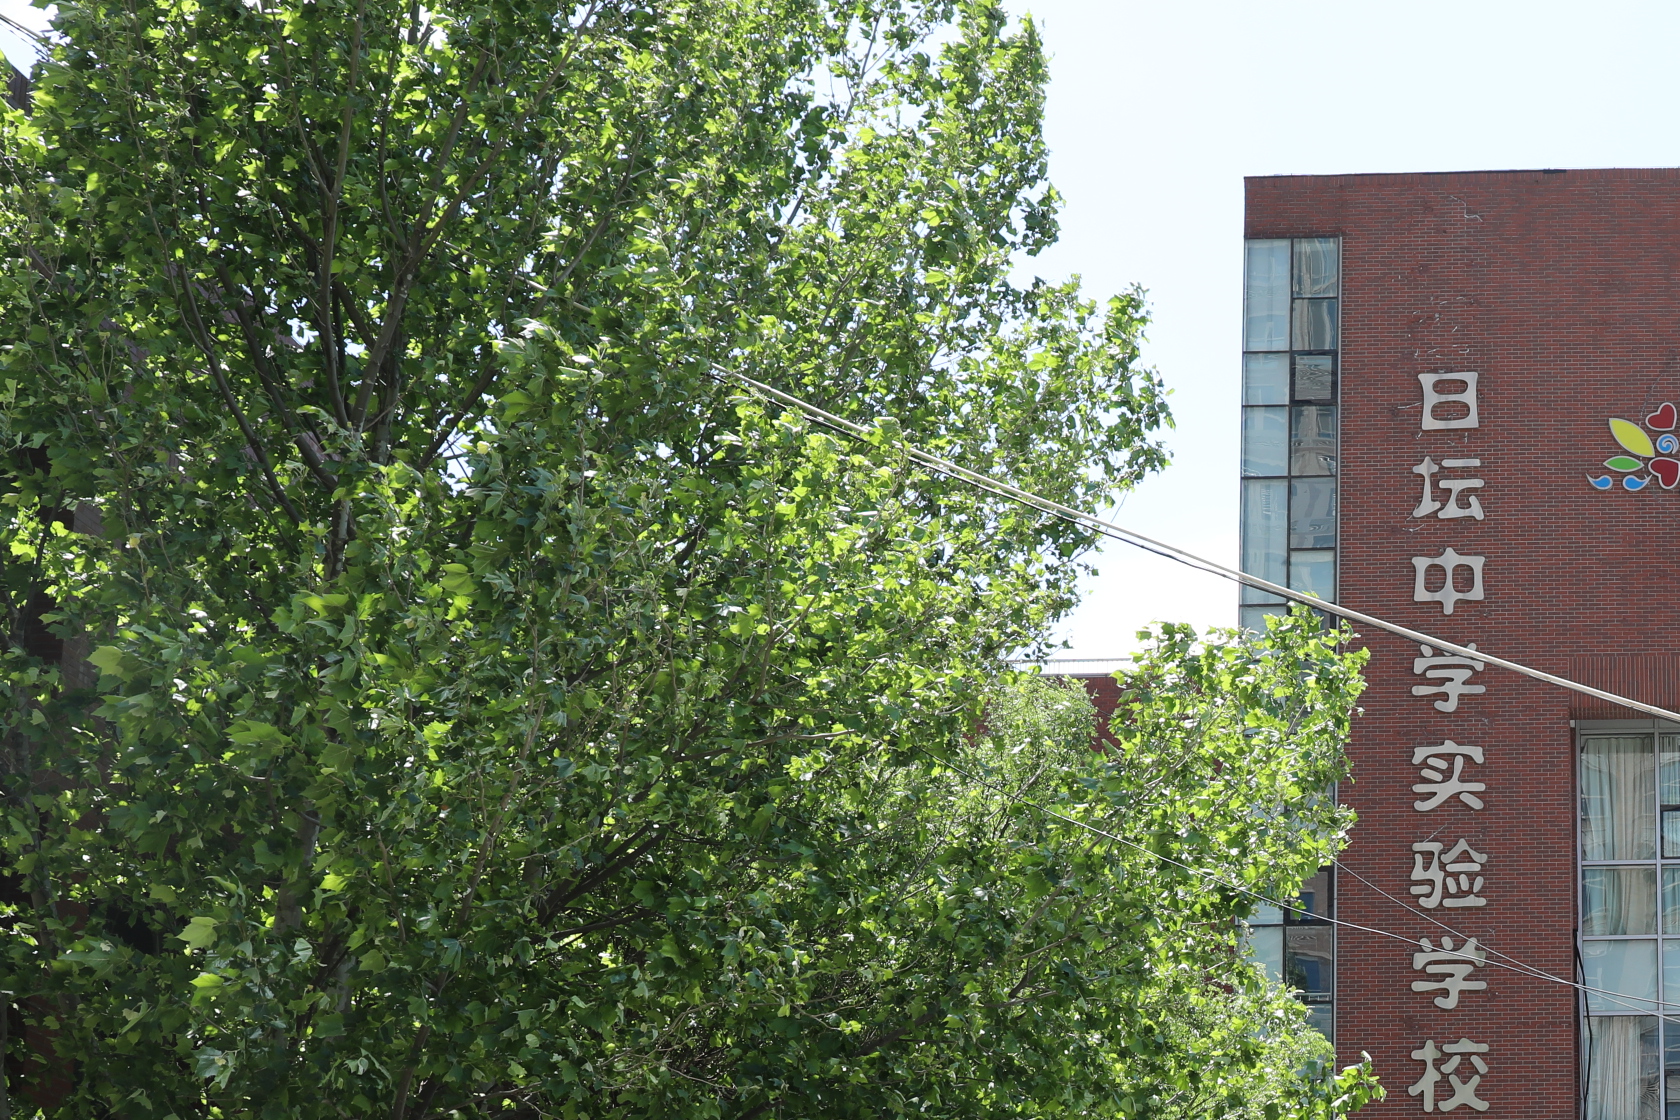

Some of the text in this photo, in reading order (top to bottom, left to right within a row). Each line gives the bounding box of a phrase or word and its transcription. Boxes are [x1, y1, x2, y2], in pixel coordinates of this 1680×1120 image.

[1408, 372, 1490, 1112] 日坛中学实验学校
